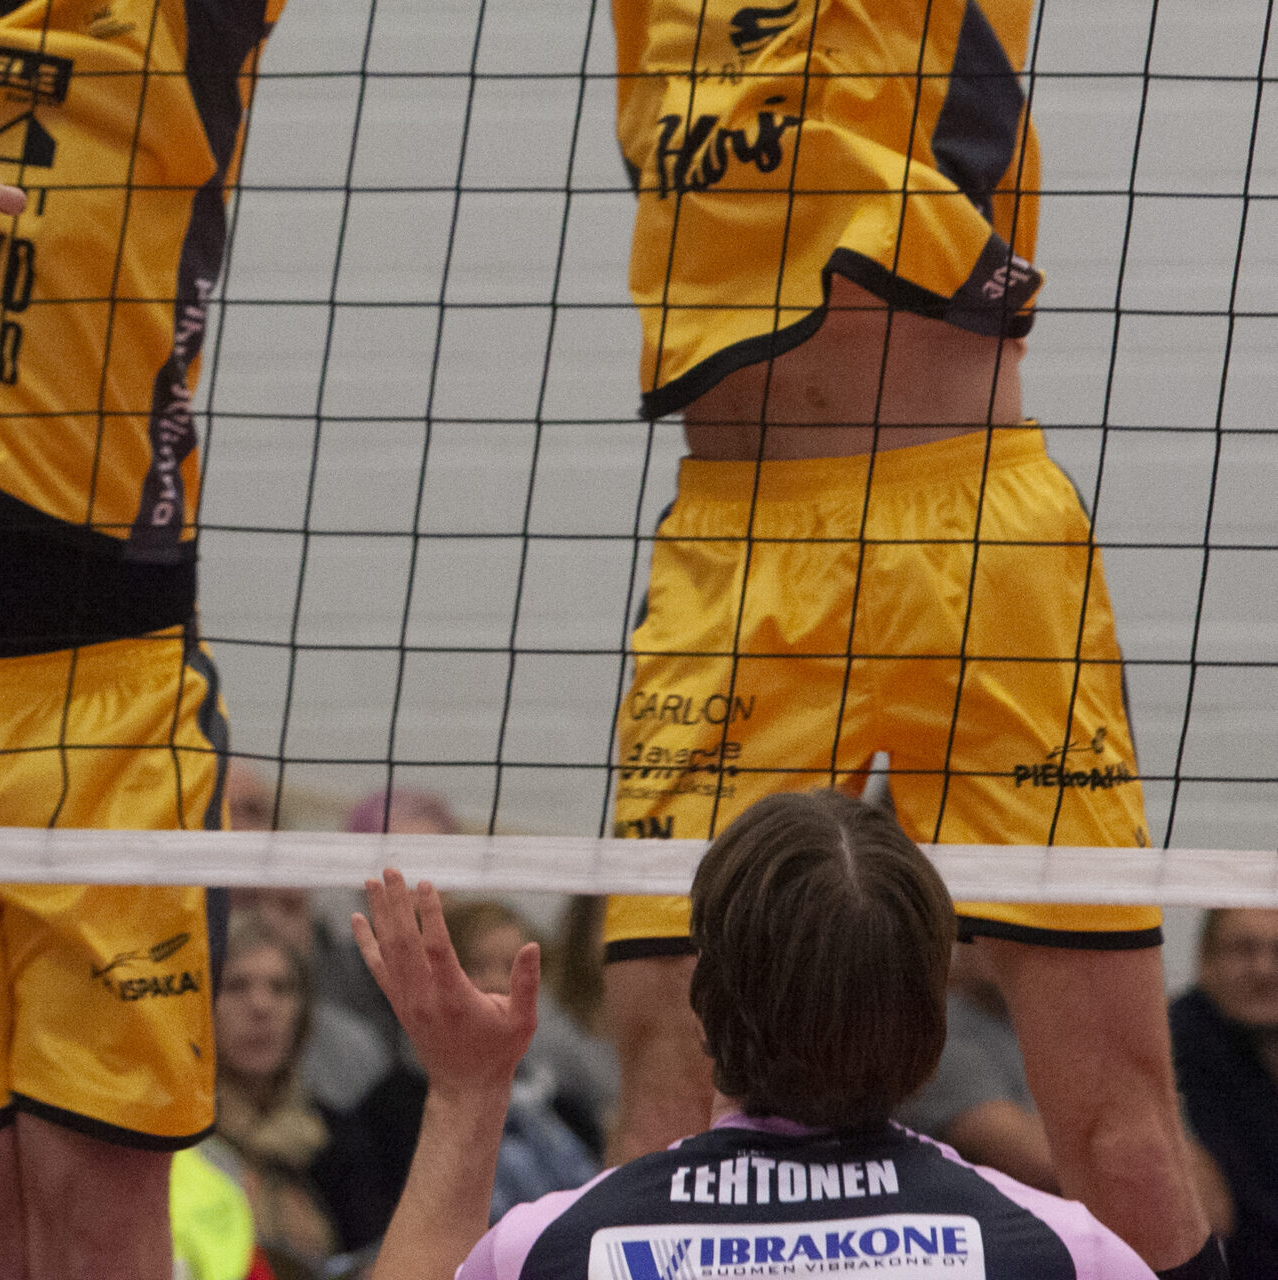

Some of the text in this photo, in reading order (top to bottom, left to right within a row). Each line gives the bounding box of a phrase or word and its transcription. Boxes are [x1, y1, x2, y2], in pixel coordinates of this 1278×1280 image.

[670, 1156, 899, 1205] LEHTONEN
[701, 1256, 969, 1278] SUOMEN VIBRAKONE OY
